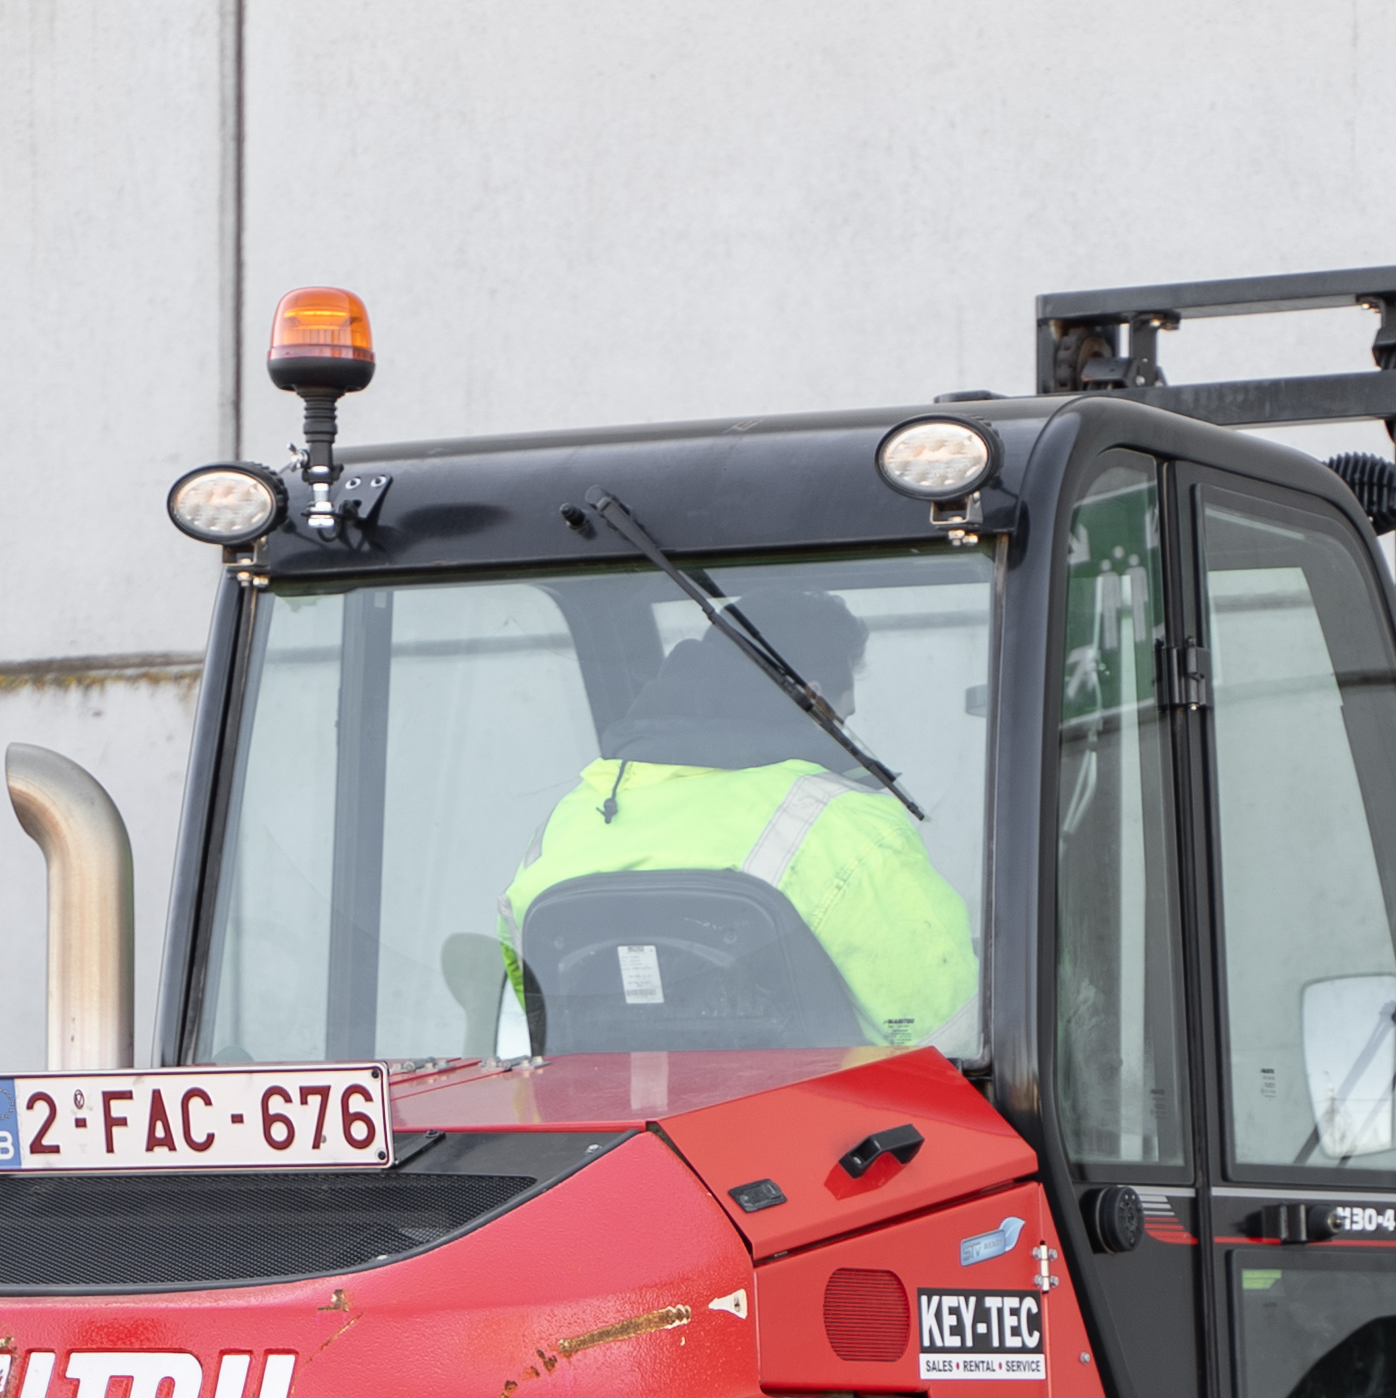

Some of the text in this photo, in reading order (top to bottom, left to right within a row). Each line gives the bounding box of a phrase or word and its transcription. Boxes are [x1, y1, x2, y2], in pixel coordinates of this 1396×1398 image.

[920, 1294, 1041, 1348] KEY-TEC
[925, 1360, 1041, 1373] SALES RENTAL SERVICE
